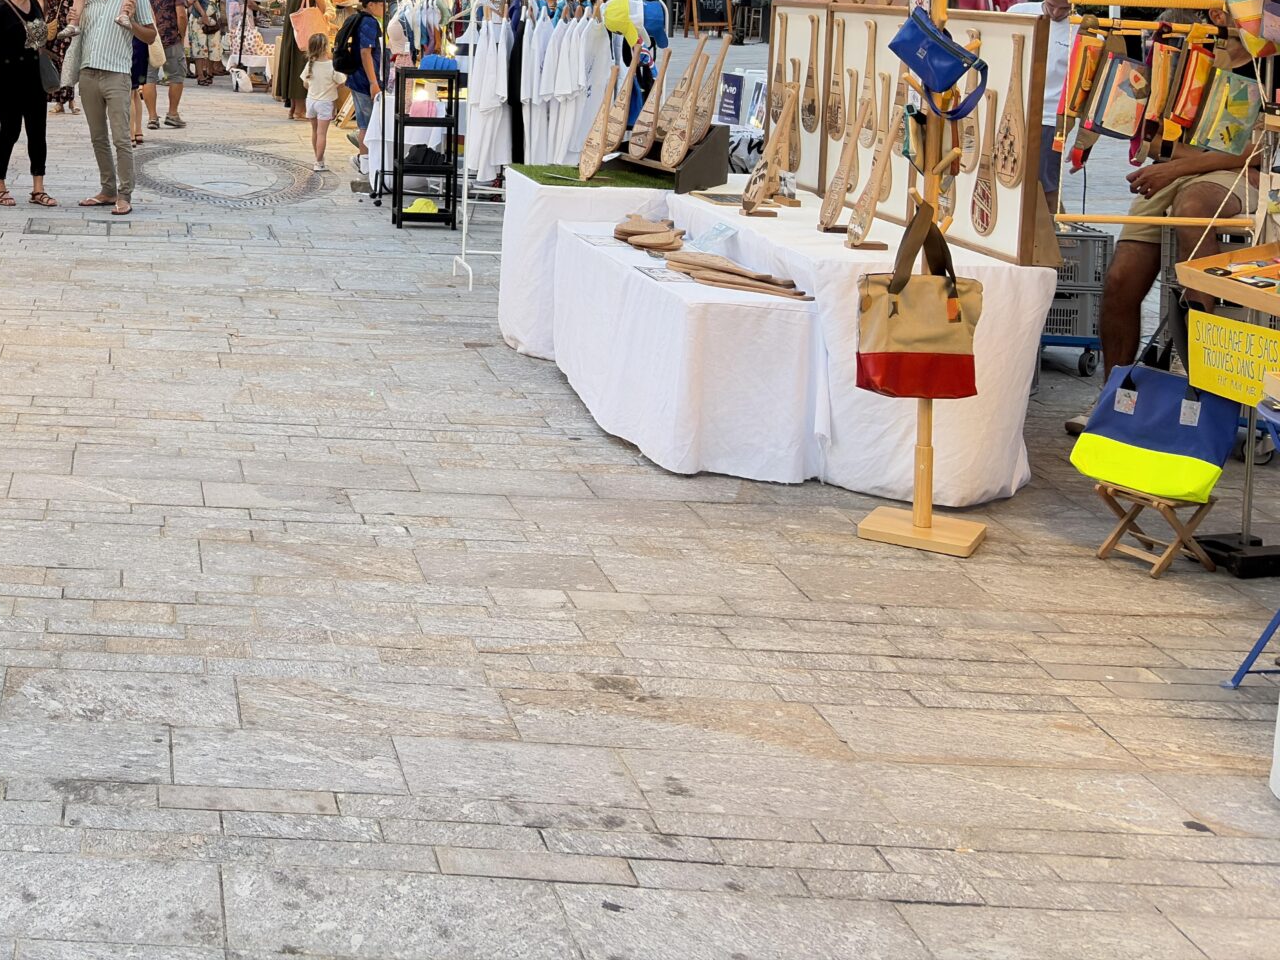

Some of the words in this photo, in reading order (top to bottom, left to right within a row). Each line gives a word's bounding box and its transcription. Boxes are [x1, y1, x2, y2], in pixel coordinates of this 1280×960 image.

[1195, 320, 1243, 353] SURCYCLAGE
[1245, 333, 1255, 357] DE
[1258, 336, 1279, 363] SACS
[1203, 346, 1234, 373] TROUVÉS
[1236, 357, 1255, 380] DANS
